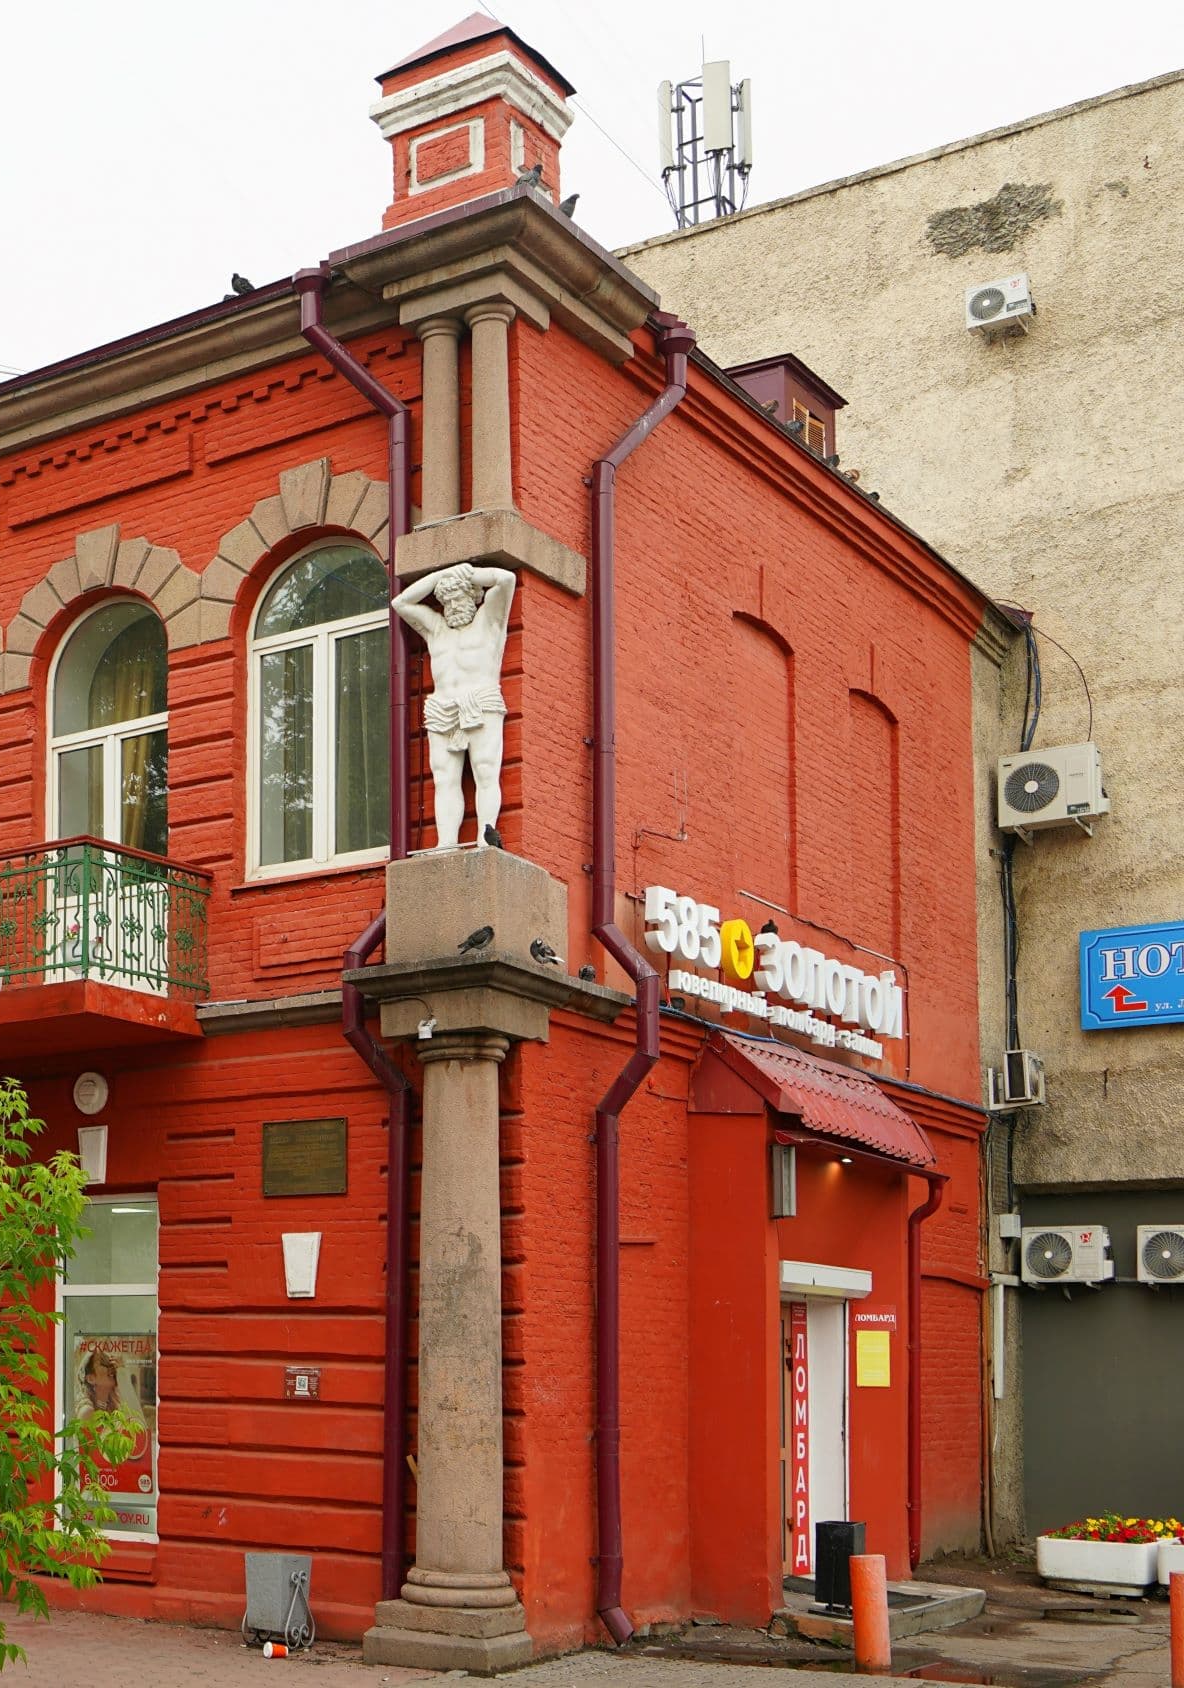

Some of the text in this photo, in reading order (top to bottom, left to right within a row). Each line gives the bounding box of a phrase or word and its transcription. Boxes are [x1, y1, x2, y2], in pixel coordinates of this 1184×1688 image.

[645, 886, 903, 1039] 585 ЗОЛОТОЙ
[669, 969, 766, 1018] ювелирный
[855, 1313, 895, 1323] ЛОМБАРД
[79, 1340, 152, 1355] #СКАЖЕТДА
[795, 1333, 808, 1568] ЛОМБАРД
